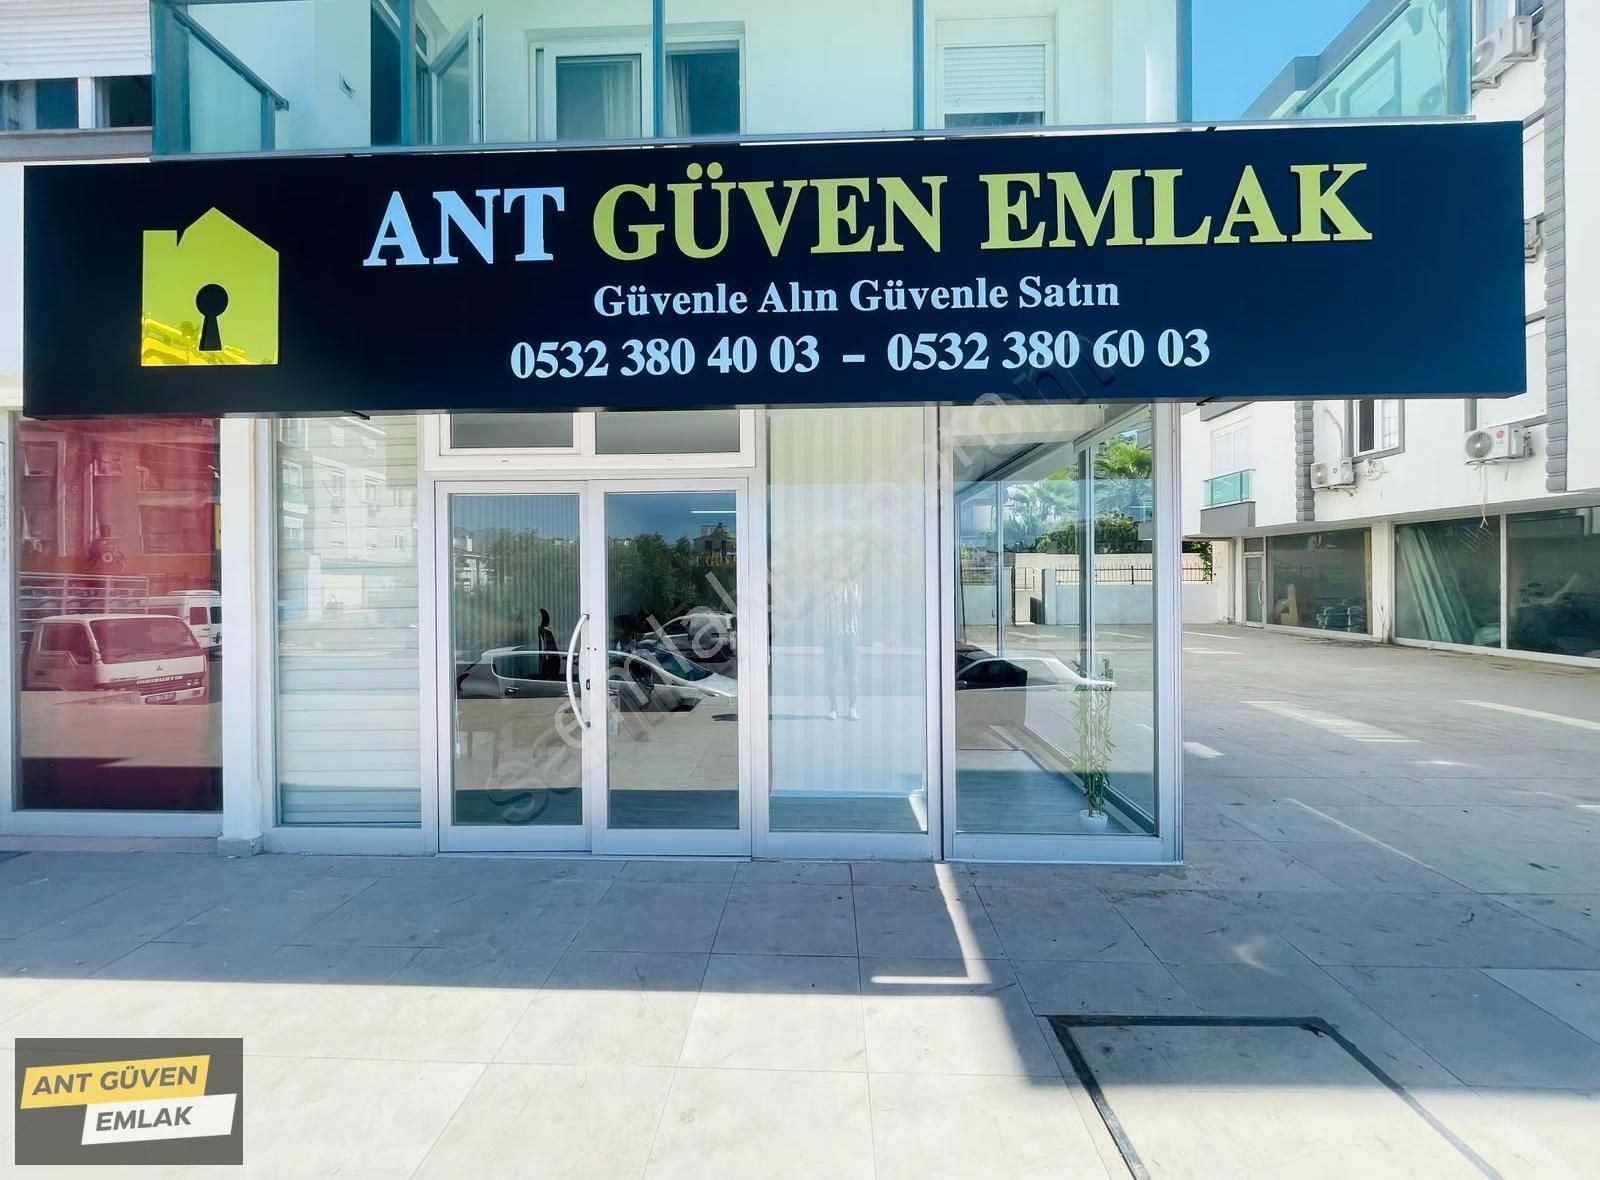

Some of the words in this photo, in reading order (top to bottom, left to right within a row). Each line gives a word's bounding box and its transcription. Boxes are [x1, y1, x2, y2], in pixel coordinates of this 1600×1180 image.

[363, 187, 565, 267] ANT
[594, 162, 948, 261] GÜVEN
[980, 164, 1373, 250] EMLAK
[594, 283, 748, 317] Güvenle
[758, 281, 839, 313] Alın
[850, 277, 1008, 312] Güvenle
[1020, 275, 1120, 309] Satın
[511, 339, 609, 379] 0532
[621, 337, 696, 377] 380
[708, 336, 758, 374] 40
[770, 335, 820, 373] 03
[888, 331, 990, 371] 0532
[1002, 330, 1080, 369] 380
[1093, 329, 1145, 368] 60
[1158, 328, 1210, 367] 03
